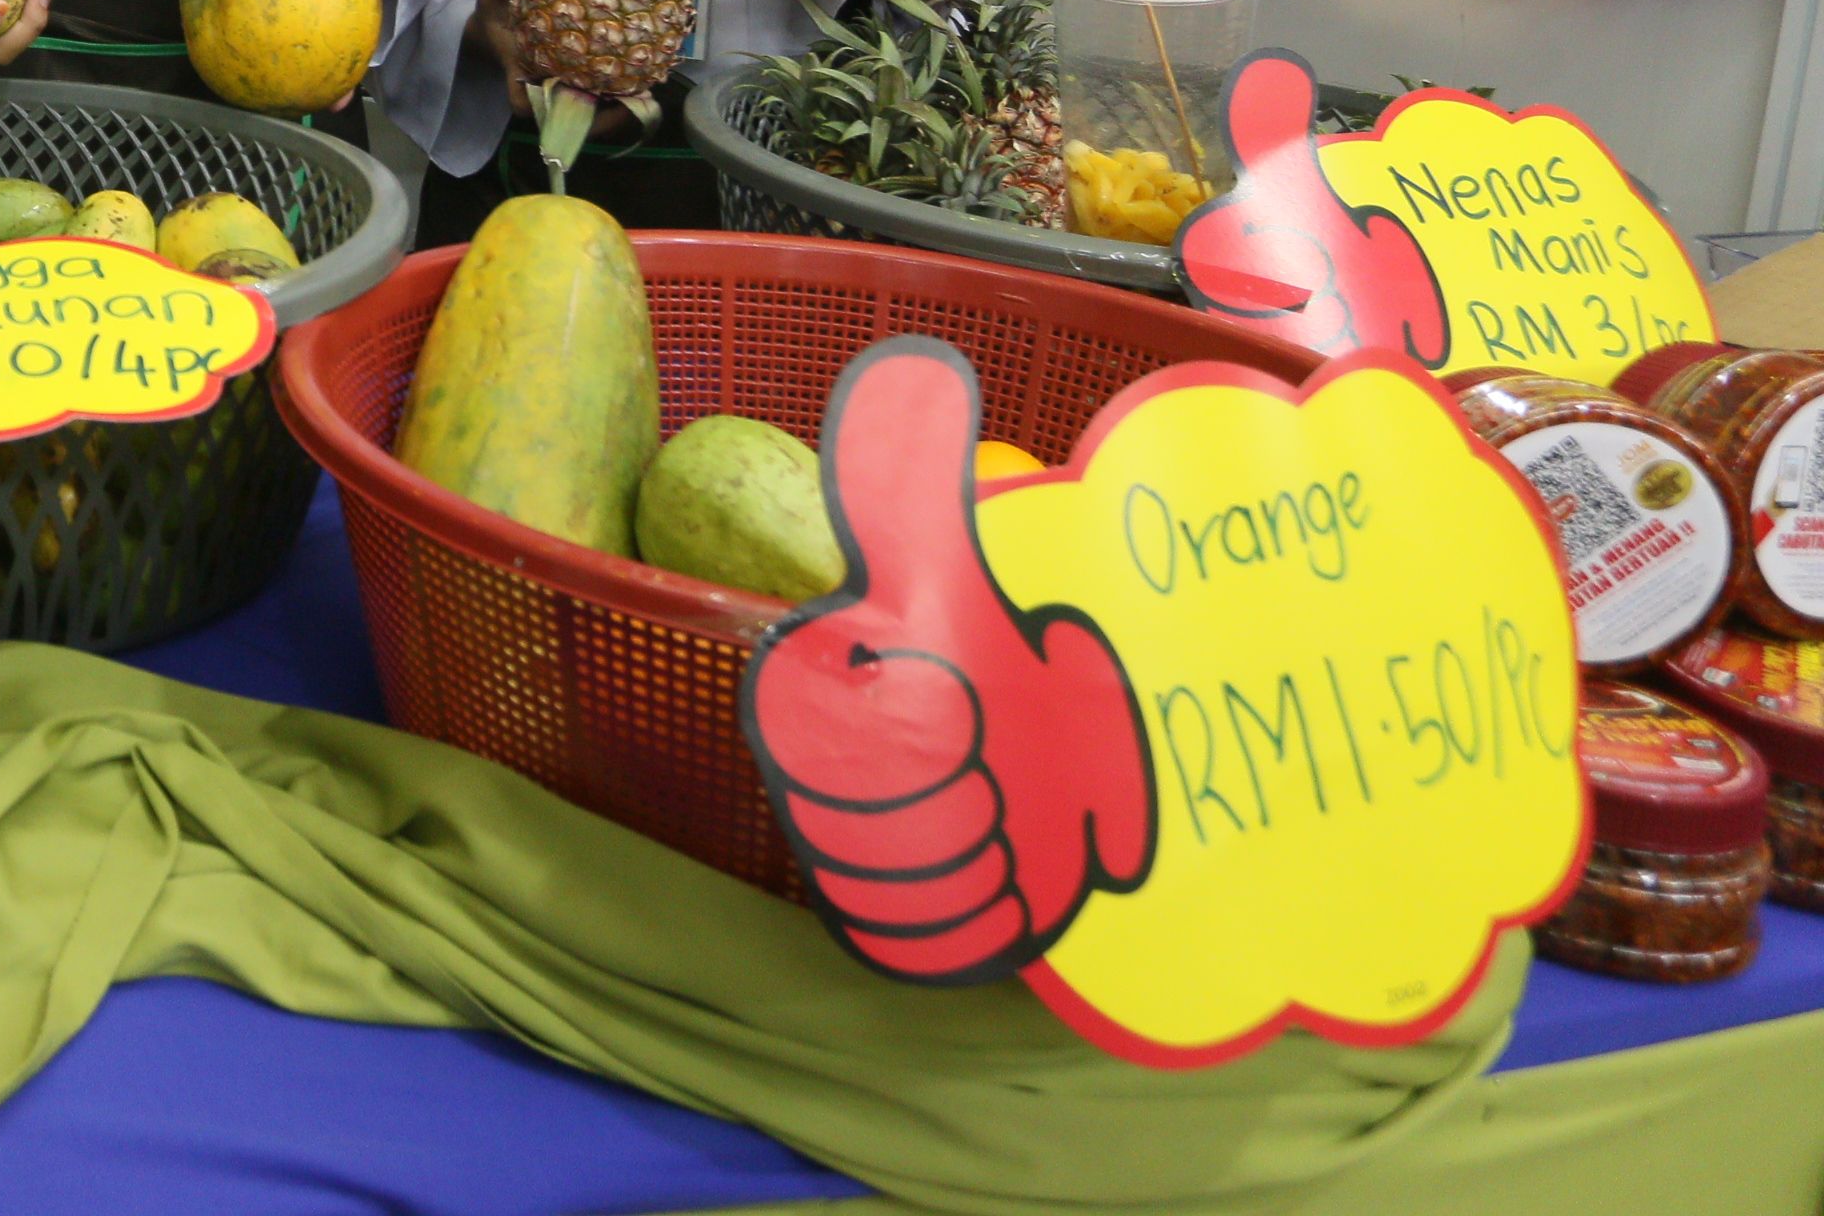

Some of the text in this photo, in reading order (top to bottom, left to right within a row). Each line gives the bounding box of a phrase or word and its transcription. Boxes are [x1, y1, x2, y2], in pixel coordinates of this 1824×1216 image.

[1386, 155, 1582, 225] Nenas
[1487, 218, 1651, 280] Manis
[1466, 299, 1578, 362] RM
[1123, 470, 1369, 595] Orange
[1568, 579, 1614, 612] UTAN
